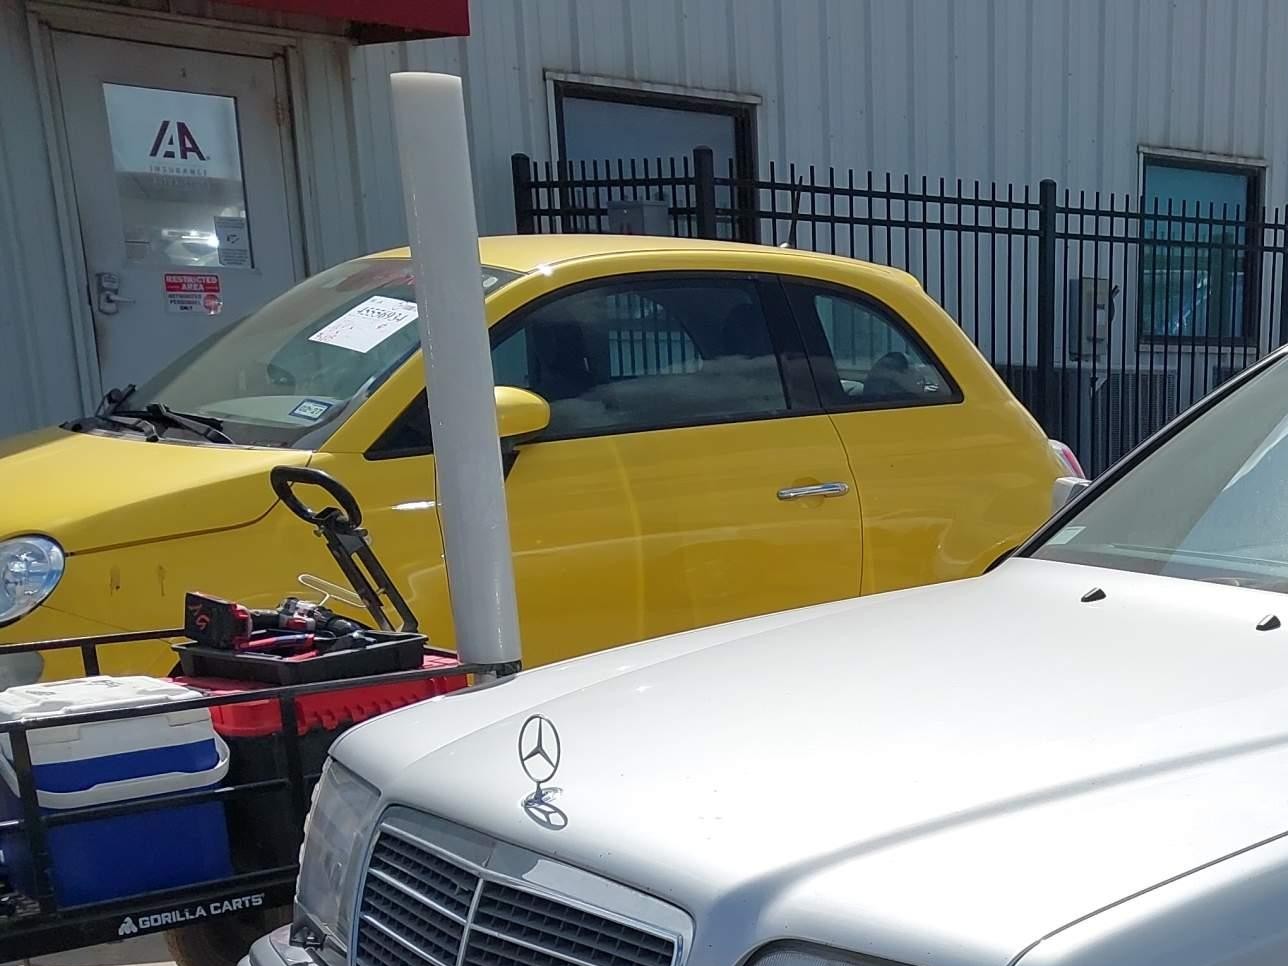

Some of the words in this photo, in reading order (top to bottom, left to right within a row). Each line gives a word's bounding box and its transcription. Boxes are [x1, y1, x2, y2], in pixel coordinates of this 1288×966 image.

[166, 275, 218, 284] RESTRICTED
[181, 282, 205, 291] AREA
[138, 906, 207, 929] GORILLA
[209, 893, 264, 915] CARTS
